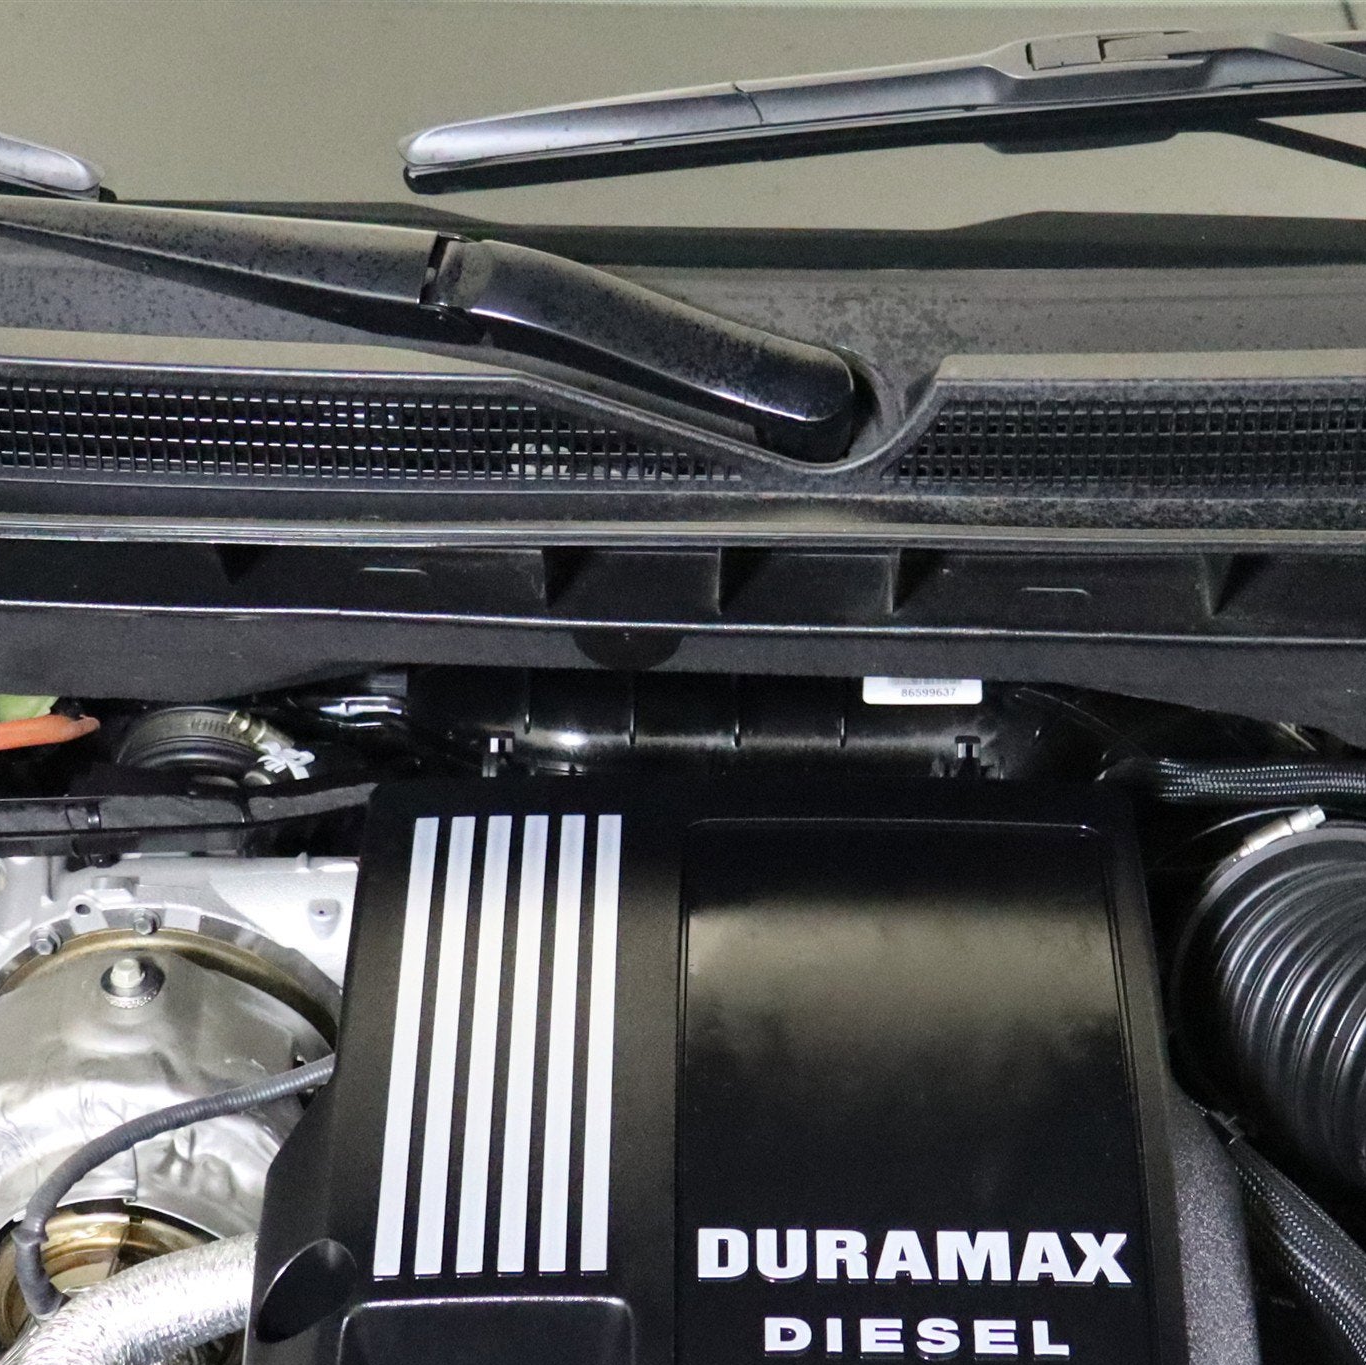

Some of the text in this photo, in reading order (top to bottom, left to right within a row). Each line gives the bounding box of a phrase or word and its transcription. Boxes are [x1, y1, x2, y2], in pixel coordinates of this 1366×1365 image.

[901, 687, 956, 698] 86599637
[698, 1227, 1132, 1286] DURAMAX
[764, 1317, 1070, 1358] DIESEL
